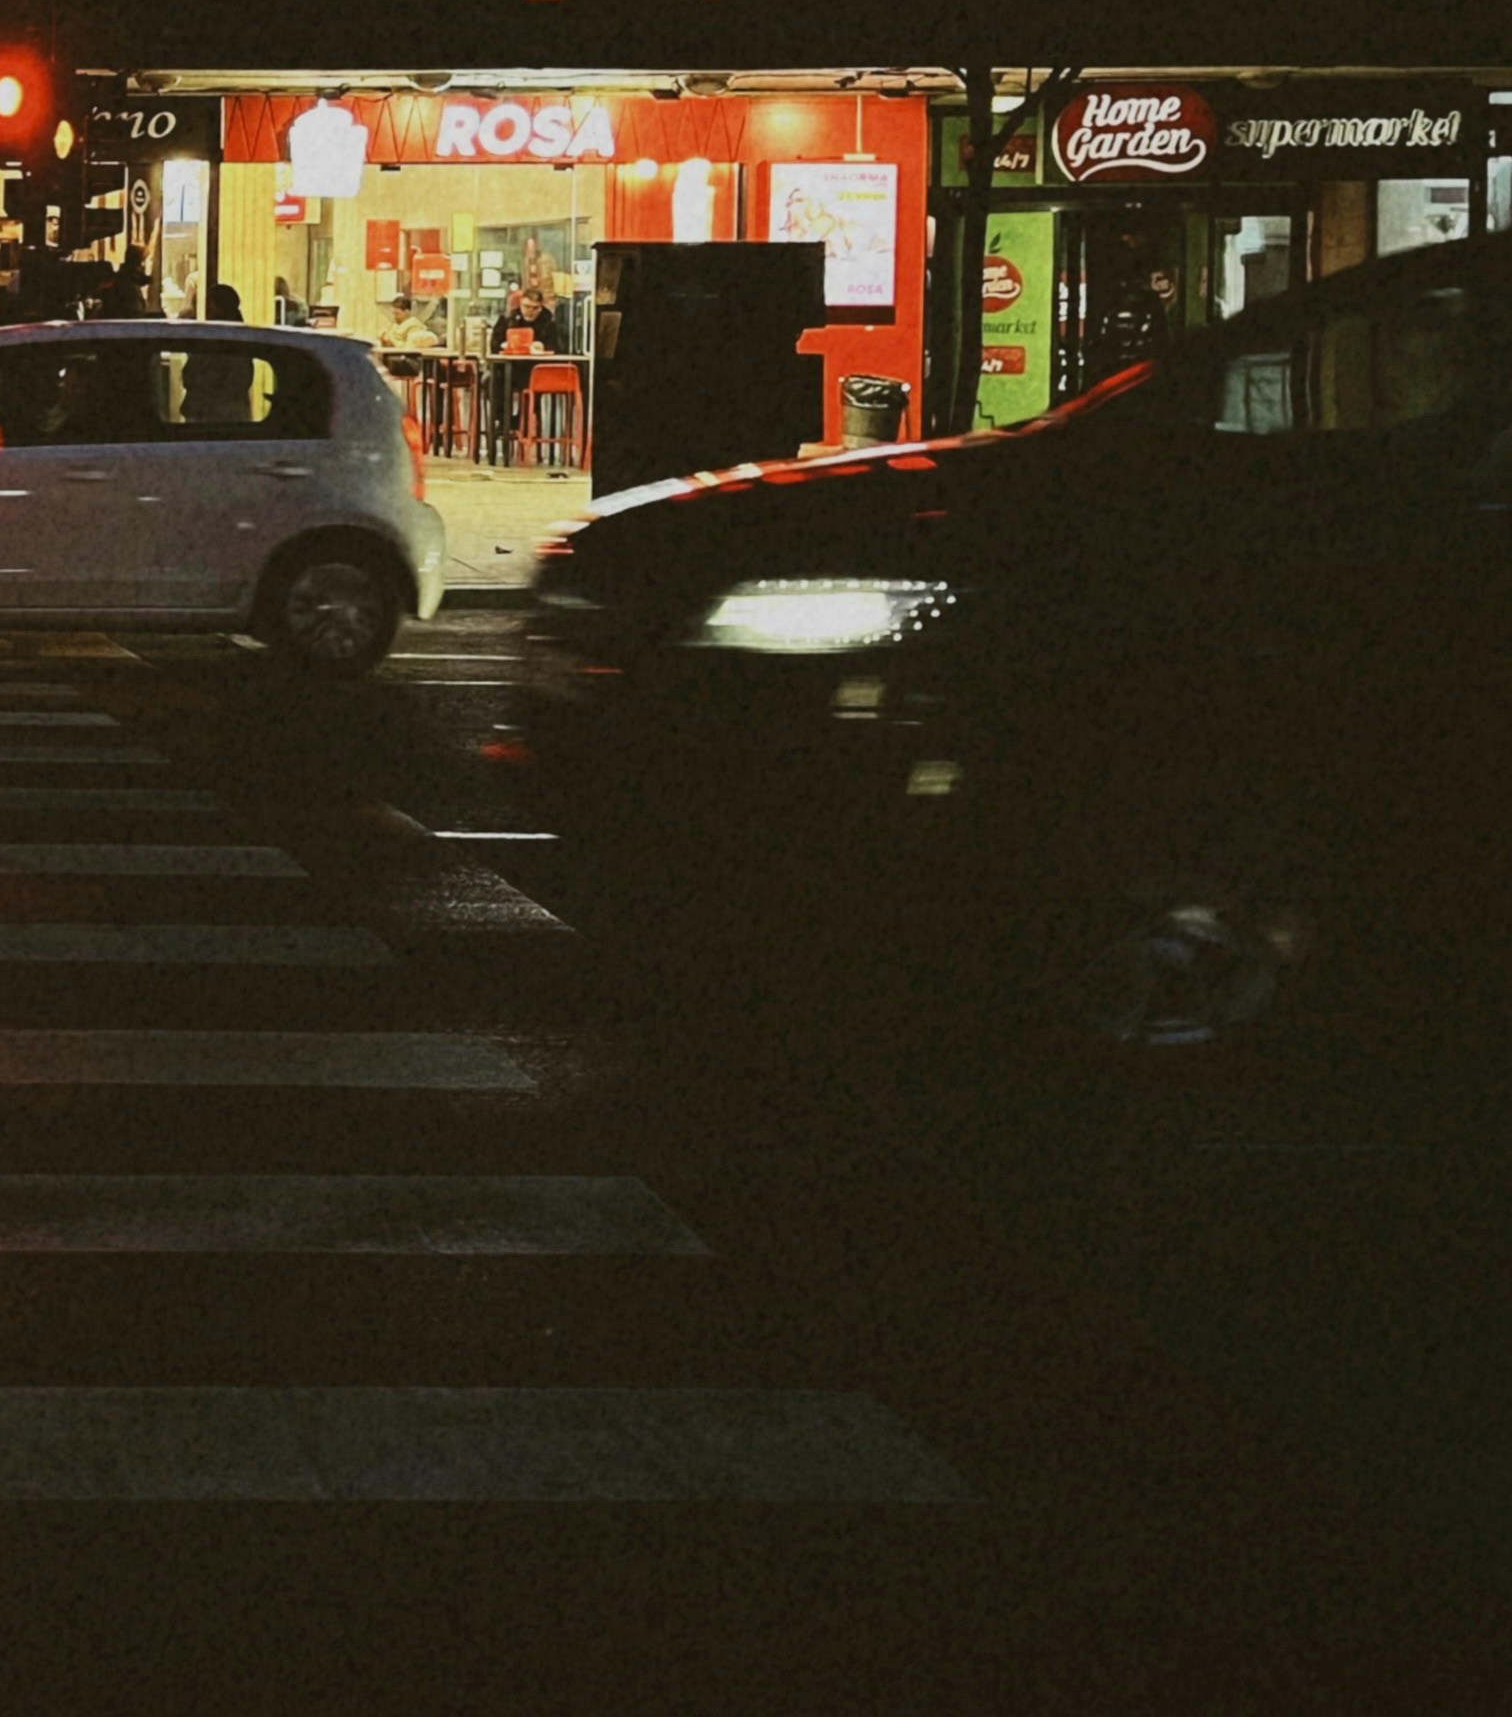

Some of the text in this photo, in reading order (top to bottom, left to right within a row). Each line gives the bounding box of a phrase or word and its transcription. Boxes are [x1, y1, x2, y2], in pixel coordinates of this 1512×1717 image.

[436, 105, 616, 159] ROSA
[1082, 92, 1182, 128] Home
[1066, 124, 1206, 169] Garden
[1225, 108, 1462, 159] supermarket
[846, 284, 885, 296] ROSA
